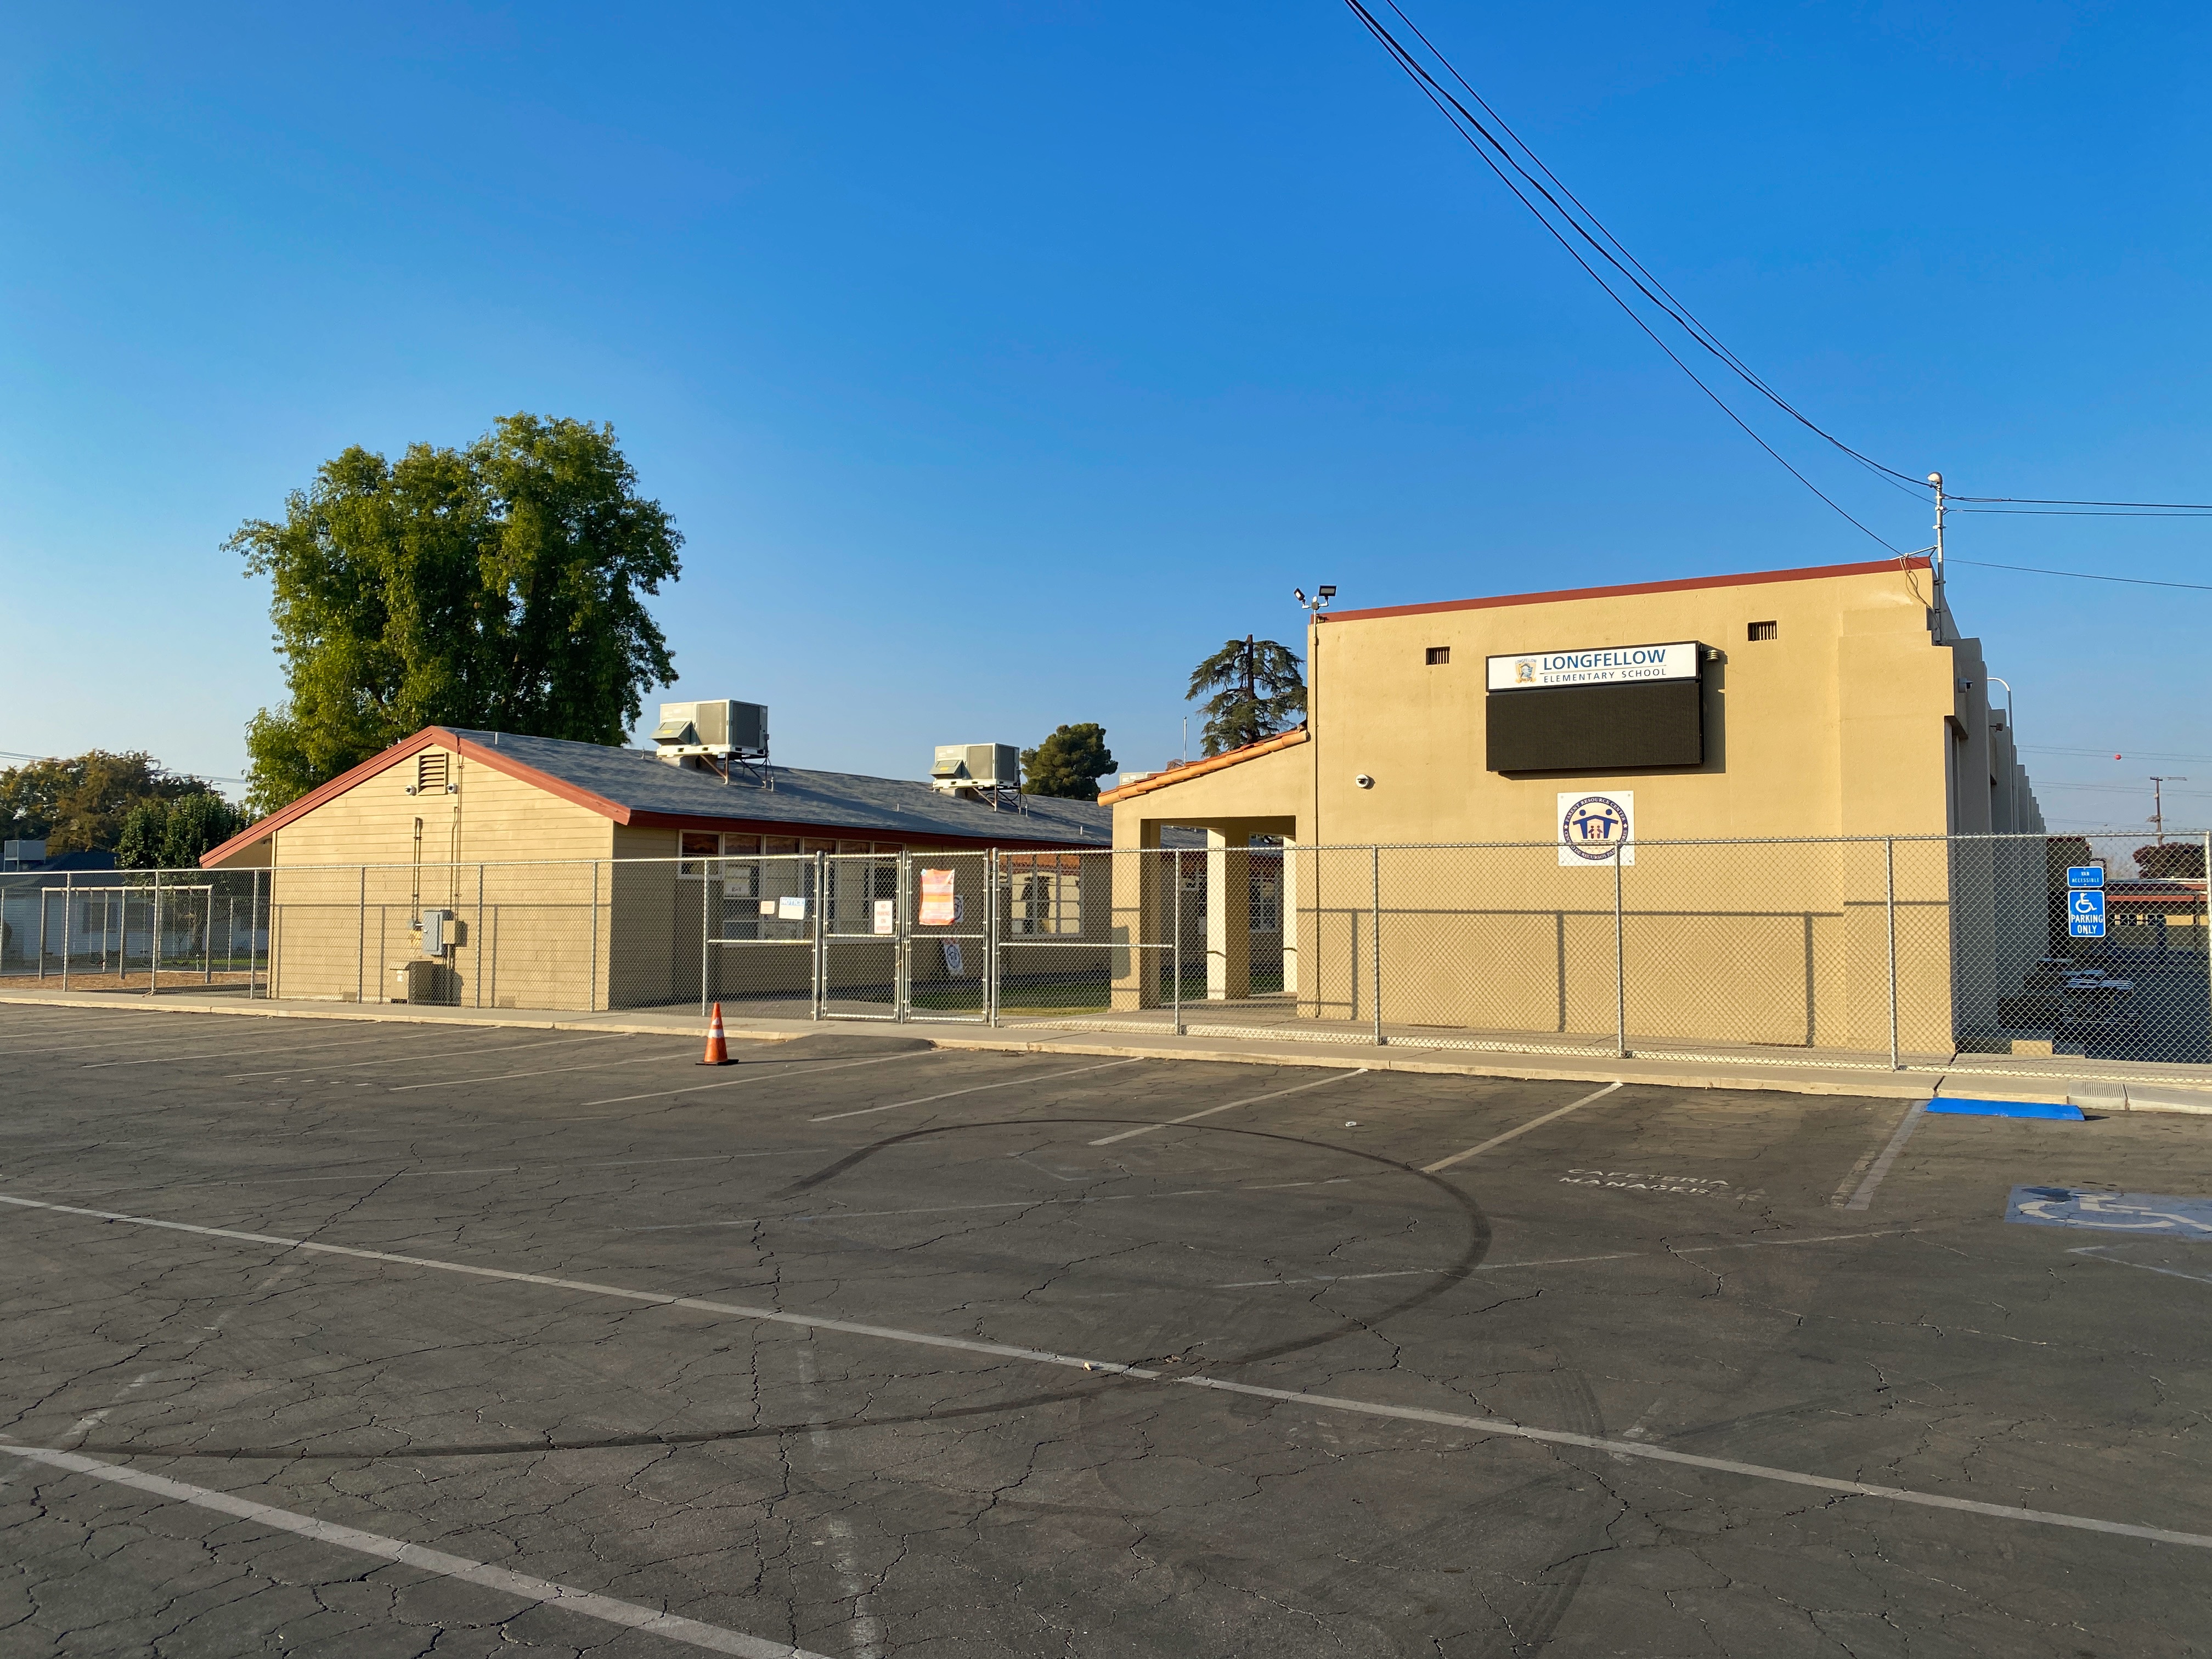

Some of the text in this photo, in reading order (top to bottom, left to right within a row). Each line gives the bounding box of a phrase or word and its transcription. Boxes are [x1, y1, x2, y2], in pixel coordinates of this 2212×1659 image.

[1544, 649, 1666, 670] LONGFELLOW
[1544, 672, 1615, 682] ELEMENTARY
[1622, 668, 1667, 678] SCHOOL
[1565, 802, 1581, 822] PARENT
[1610, 801, 1627, 821] CENTER
[1564, 830, 1576, 850] CENTO
[781, 898, 804, 906] NOTICE
[2071, 914, 2103, 923] PARKING
[2077, 924, 2097, 934] ONLY
[1558, 1177, 1711, 1194] MANAGER
[1567, 1169, 1729, 1186] CAFETERIA
